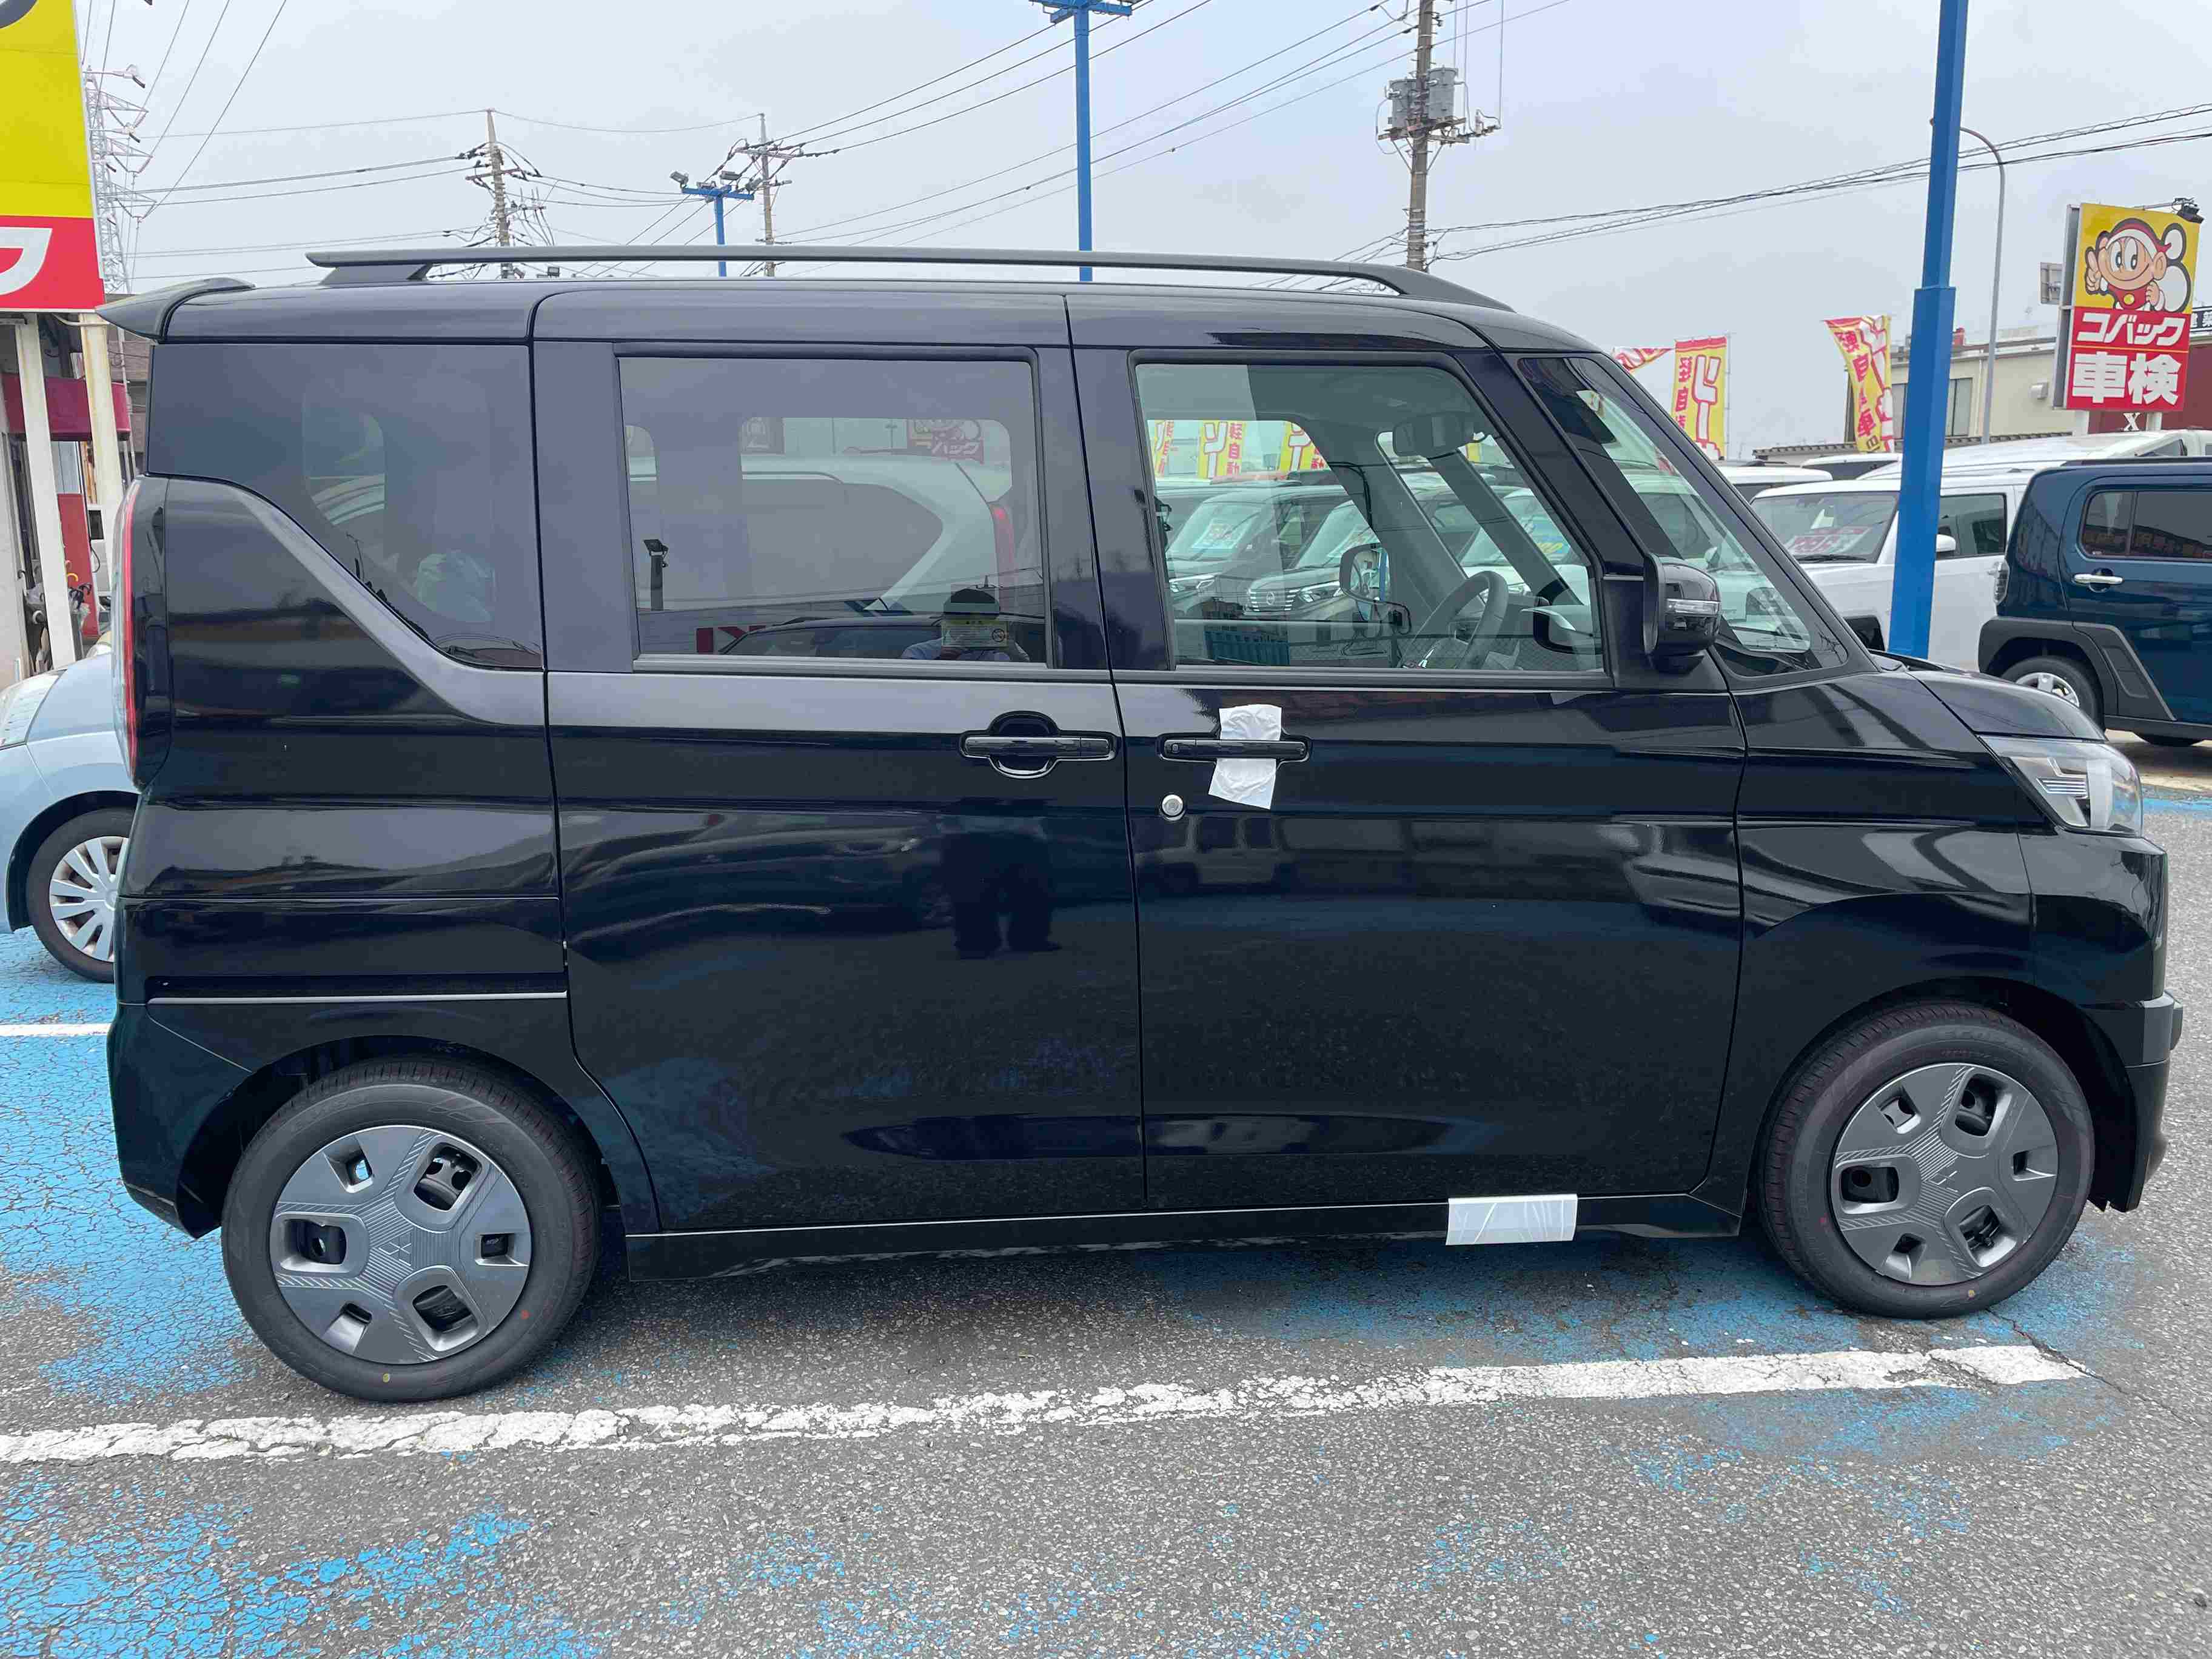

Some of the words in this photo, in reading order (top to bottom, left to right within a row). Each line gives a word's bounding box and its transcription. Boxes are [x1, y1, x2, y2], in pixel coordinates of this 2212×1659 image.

[2077, 312, 2186, 346] コバック
[2071, 351, 2183, 406] 車検
